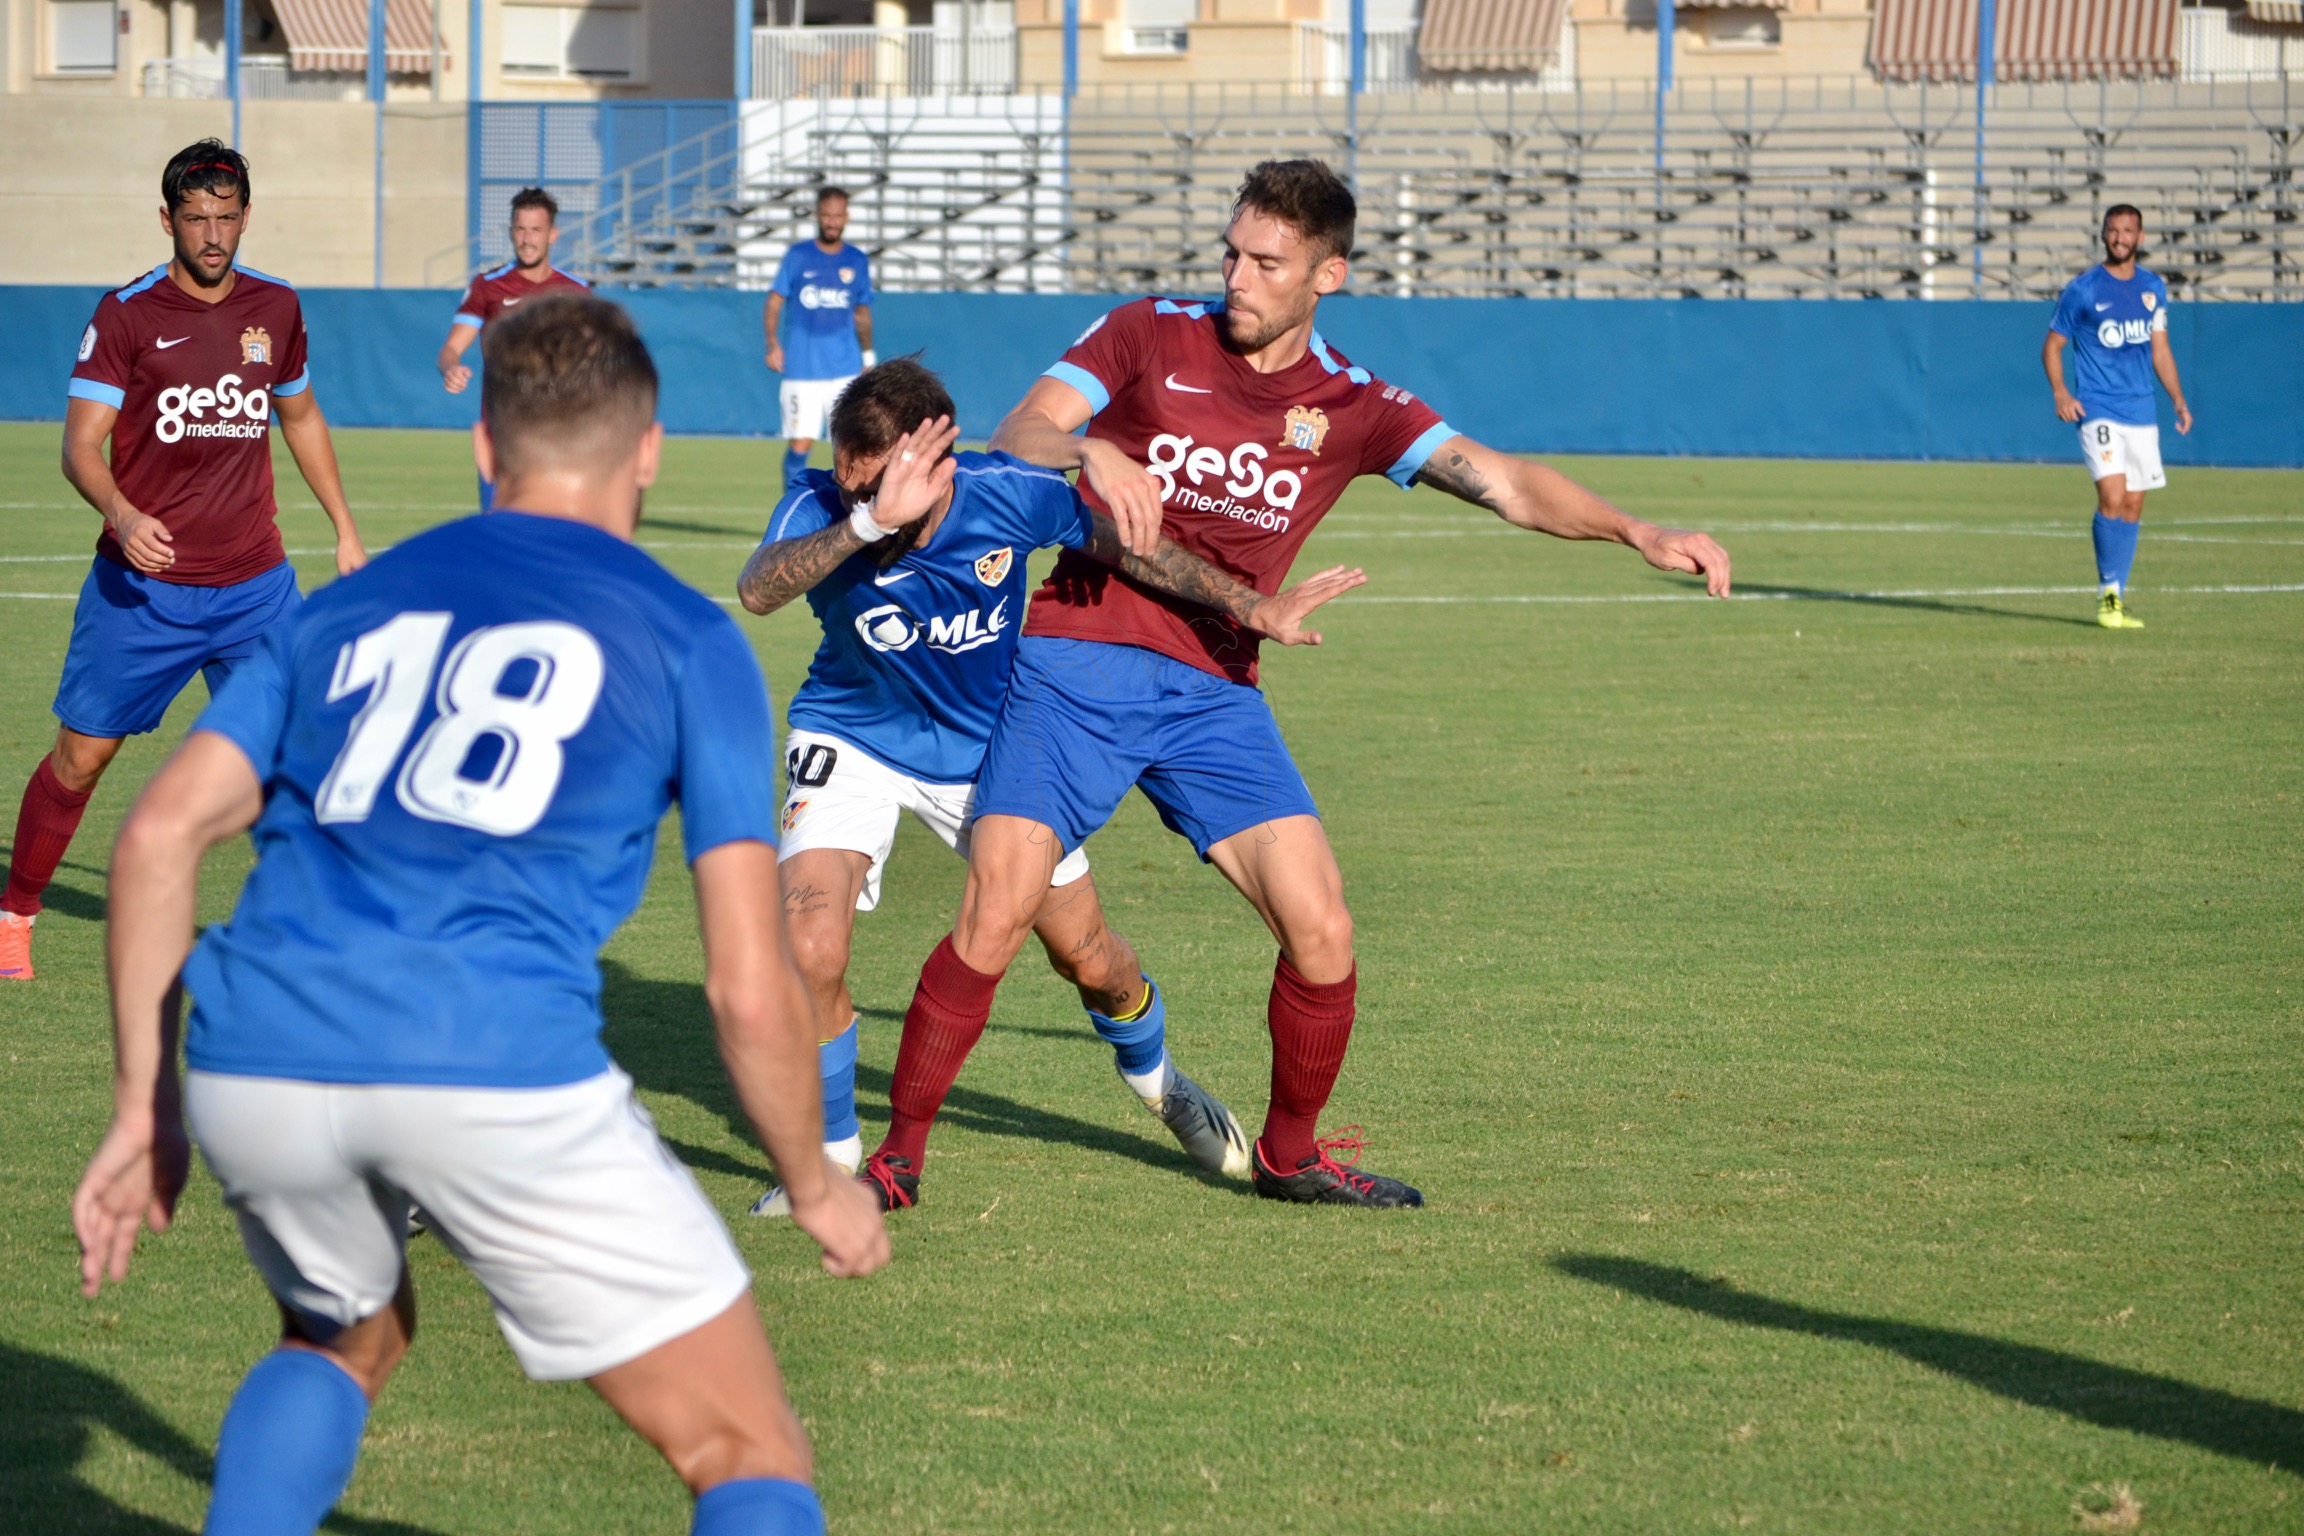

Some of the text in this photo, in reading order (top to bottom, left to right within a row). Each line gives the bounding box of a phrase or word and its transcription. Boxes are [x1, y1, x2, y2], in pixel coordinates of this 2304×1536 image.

[790, 395, 799, 415] 5
[2097, 424, 2111, 446] 8
[1174, 486, 1290, 534] mediación
[315, 611, 606, 838] 18
